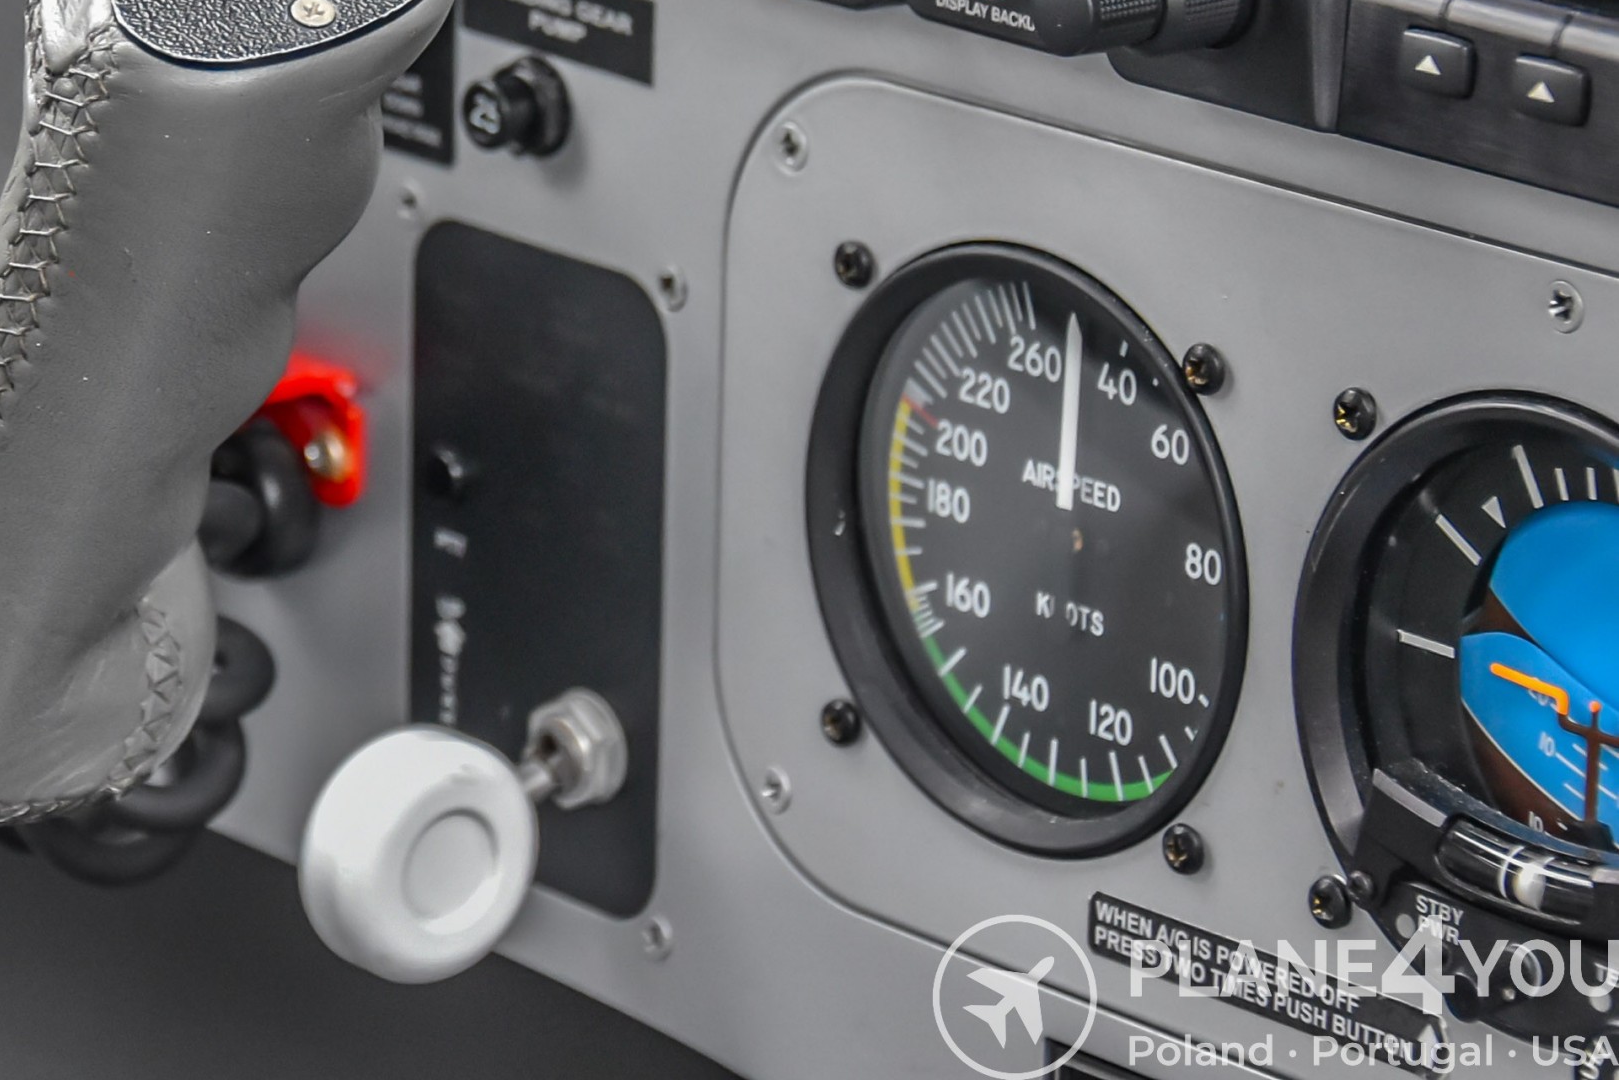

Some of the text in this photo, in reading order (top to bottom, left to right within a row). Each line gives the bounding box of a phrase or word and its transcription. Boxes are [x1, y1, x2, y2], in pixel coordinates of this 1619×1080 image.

[1008, 335, 1063, 384] 260
[959, 368, 1011, 414] 220
[1098, 361, 1137, 406] 40
[935, 419, 988, 467] 200
[1151, 424, 1190, 466] 60
[927, 478, 971, 523] 180
[1022, 459, 1121, 513] AIRPEED
[1185, 543, 1221, 587] 80
[946, 572, 991, 618] 160
[1035, 591, 1105, 637] KOTS
[1003, 665, 1049, 711] 140
[1150, 657, 1195, 704] 100
[1089, 700, 1133, 746] 120
[1538, 731, 1555, 757] 10
[1415, 895, 1464, 926] STBY
[1417, 916, 1460, 945] PWR
[1095, 900, 1361, 1014] WHEN A/C IS POWERED OFF
[1094, 926, 1415, 1059] PRESS TWO TIMES PUSH BUTTON
